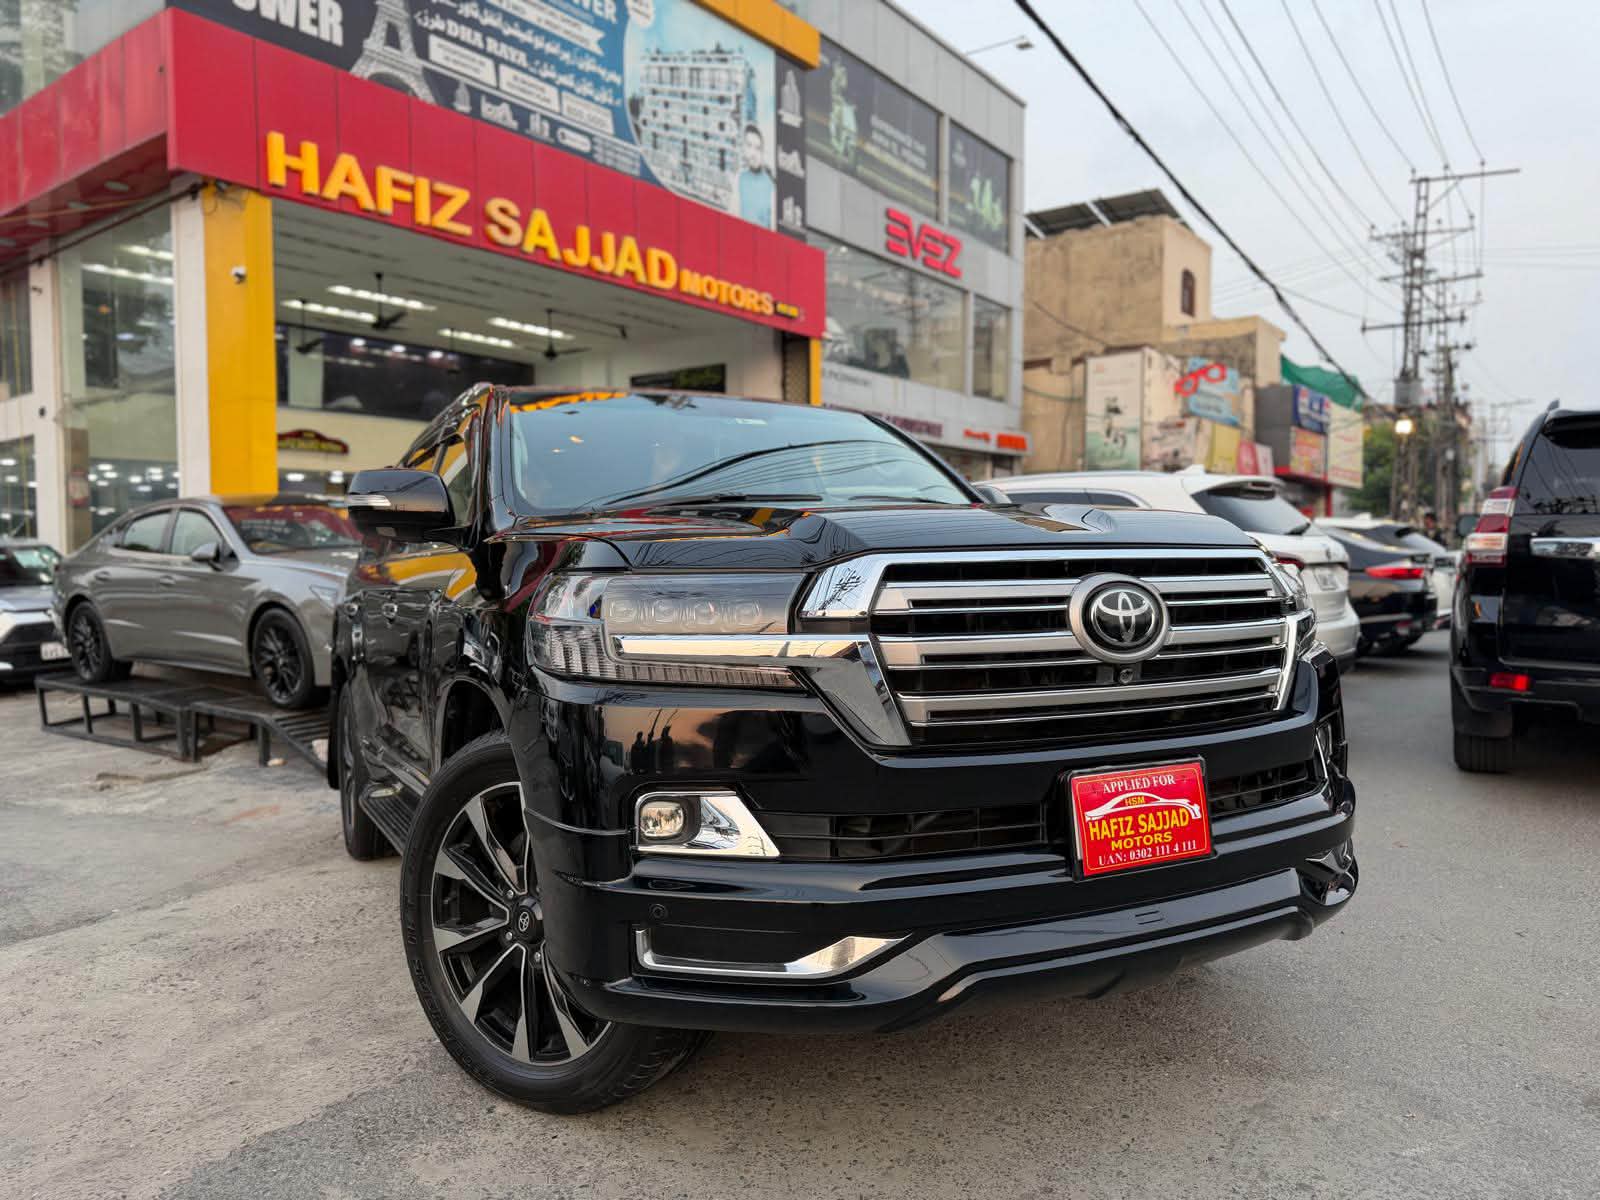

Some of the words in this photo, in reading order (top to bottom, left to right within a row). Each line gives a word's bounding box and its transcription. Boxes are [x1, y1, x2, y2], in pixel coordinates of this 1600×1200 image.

[232, 0, 343, 47] WER
[446, 19, 484, 50] DHA
[266, 130, 473, 236] HAFIZ
[485, 197, 678, 290] SAJJAD
[679, 268, 774, 316] MOTORS
[1103, 778, 1150, 794] APPLIED
[1152, 775, 1175, 787] FOR
[1089, 816, 1135, 841] HAFIZ
[1138, 809, 1188, 832] SAJJAD
[1098, 853, 1127, 866] UAN:
[1129, 847, 1153, 861] 0302
[1155, 845, 1170, 856] 111
[1173, 843, 1180, 855] 4
[1182, 840, 1196, 851] 111
[1111, 832, 1172, 850] MOTORS
